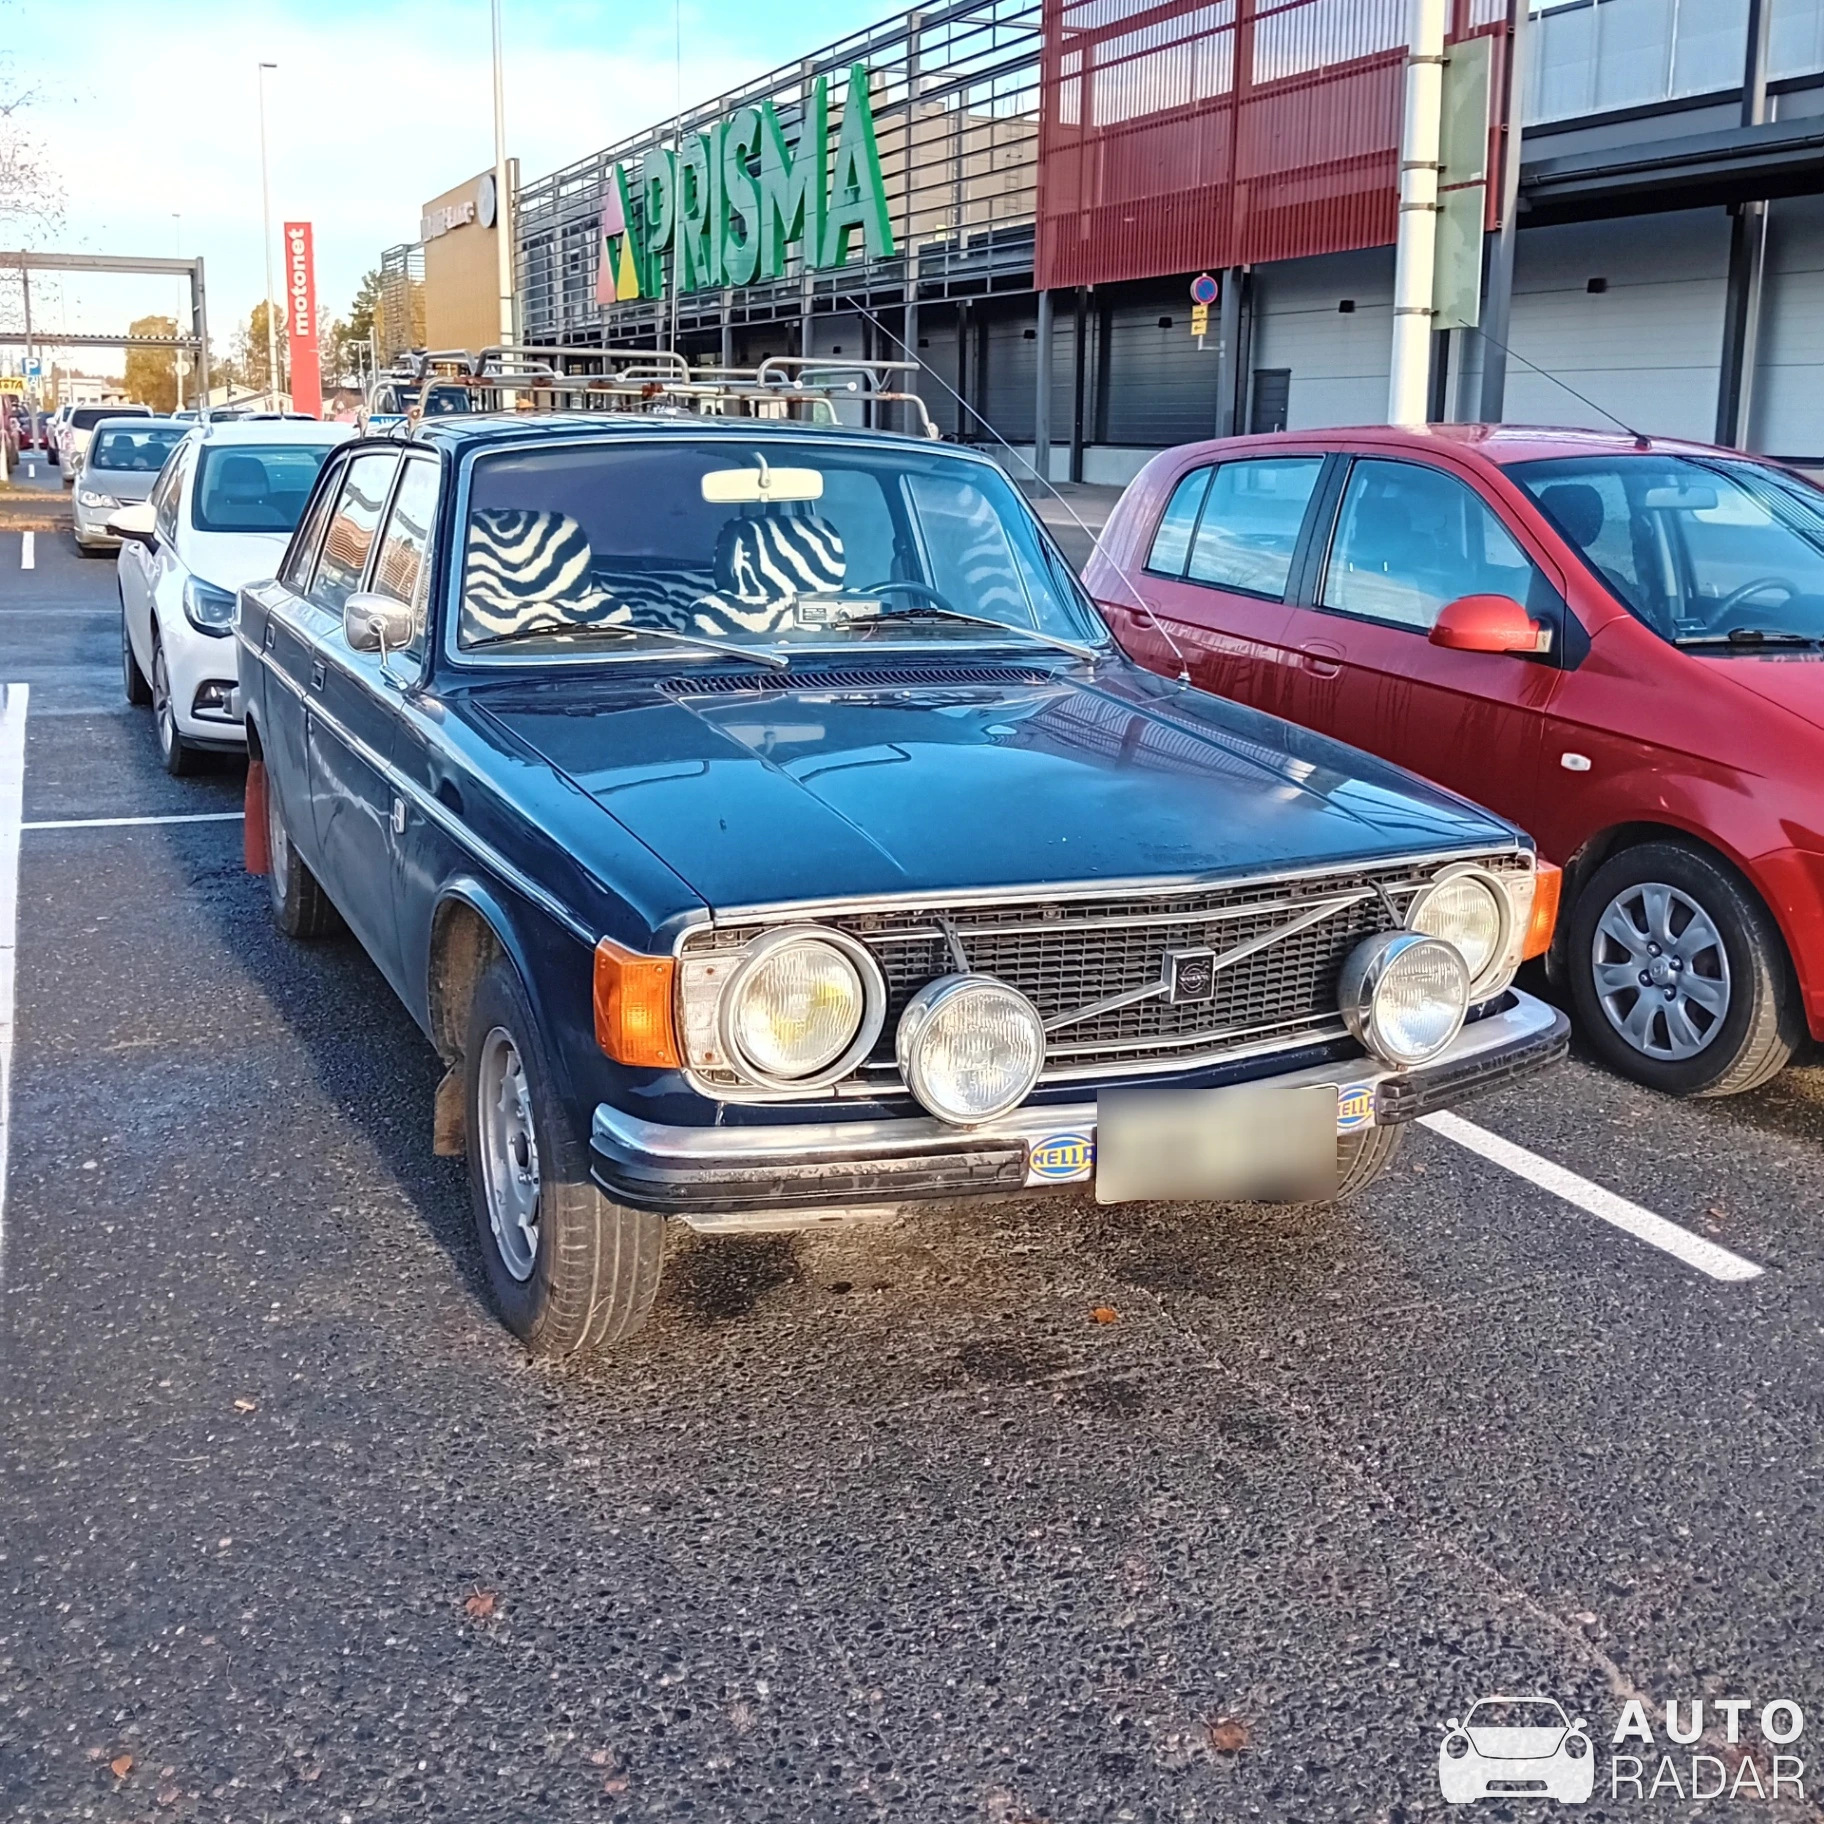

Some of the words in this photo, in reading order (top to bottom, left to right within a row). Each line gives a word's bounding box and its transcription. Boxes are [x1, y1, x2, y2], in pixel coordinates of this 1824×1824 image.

[643, 63, 895, 298] PRISMA
[288, 228, 309, 336] motonet
[25, 358, 39, 374] P
